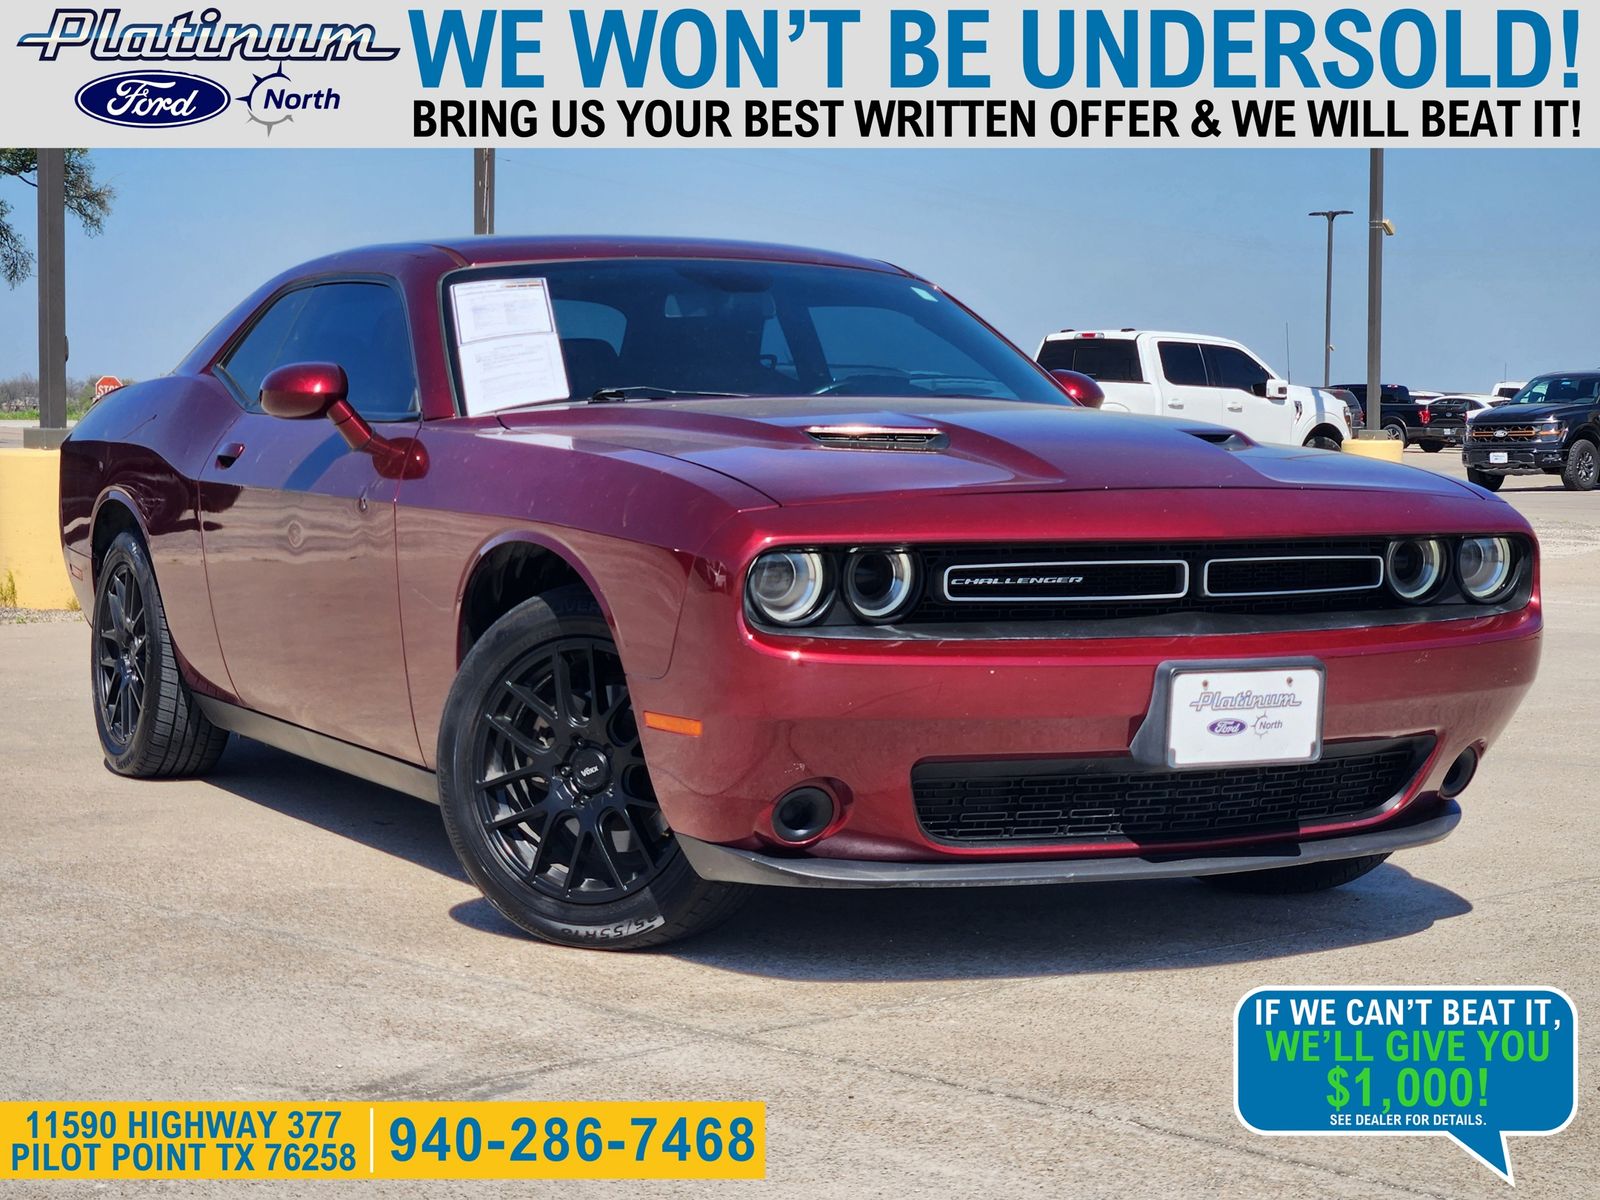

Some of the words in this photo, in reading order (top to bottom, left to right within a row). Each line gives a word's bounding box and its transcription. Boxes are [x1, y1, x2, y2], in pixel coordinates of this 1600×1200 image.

[951, 577, 1084, 585] CHALLENGER
[1189, 690, 1302, 712] Platinum
[1258, 721, 1283, 730] North
